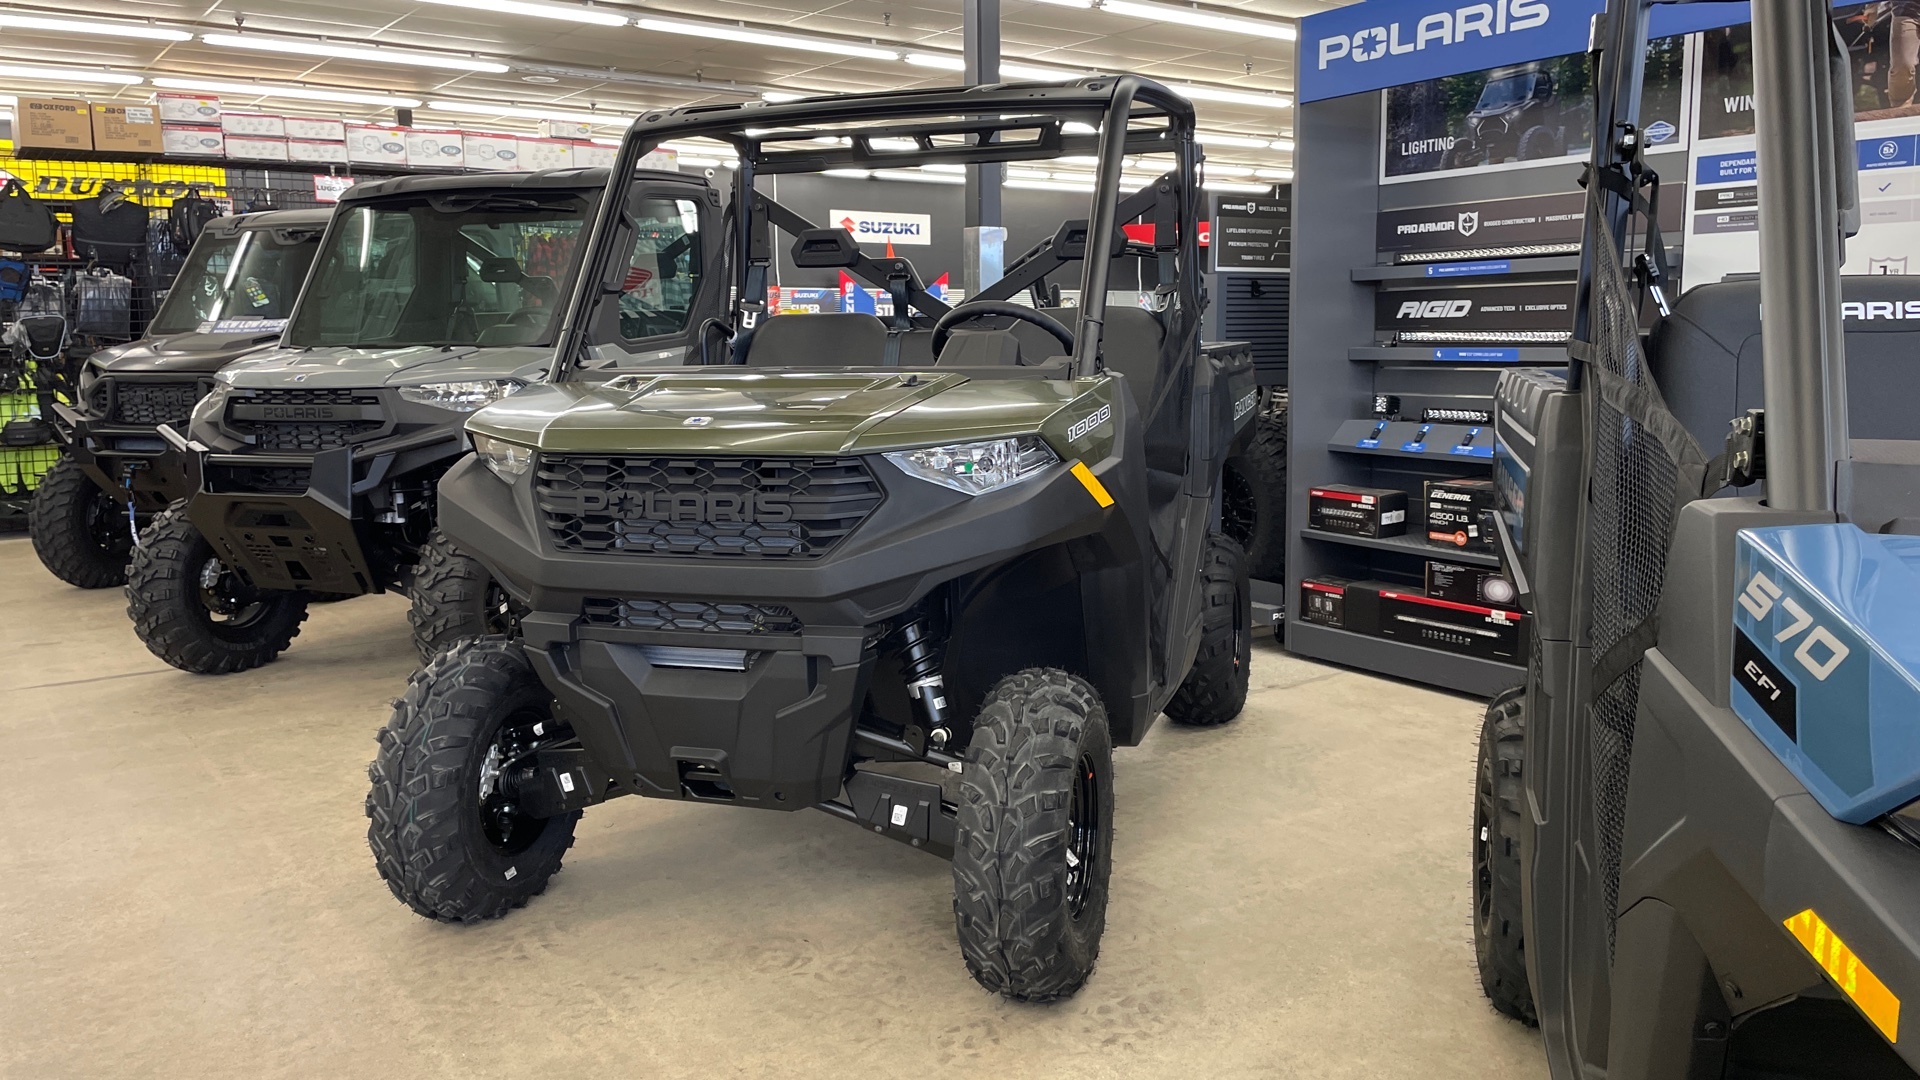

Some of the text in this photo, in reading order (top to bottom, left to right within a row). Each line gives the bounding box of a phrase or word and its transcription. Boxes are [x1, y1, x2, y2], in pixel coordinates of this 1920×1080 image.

[1318, 0, 1550, 70] POLARIS
[43, 103, 76, 112] OXFORD
[1401, 136, 1455, 156] LIGHTING
[1720, 158, 1756, 168] DEPENDAB
[1720, 168, 1738, 176] BUILT
[1739, 166, 1752, 174] FOR
[859, 220, 920, 236] SUZUKI
[1397, 223, 1418, 235] PRO
[1417, 220, 1455, 233] ARMOR
[1501, 217, 1536, 226] CONSTRUCTION
[1545, 214, 1572, 222] MASSIVELY
[845, 281, 855, 312] SUZ
[1396, 300, 1473, 319] RIGID
[217, 320, 240, 329] NEW
[240, 320, 261, 328] LOW
[263, 407, 334, 419] POLARIS
[1068, 403, 1111, 443] 1000
[1430, 491, 1472, 502] GENERAL
[576, 490, 794, 523] POLARIS
[1430, 512, 1454, 521] 4500
[1738, 570, 1850, 682] 570
[1744, 660, 1782, 701] EFI
